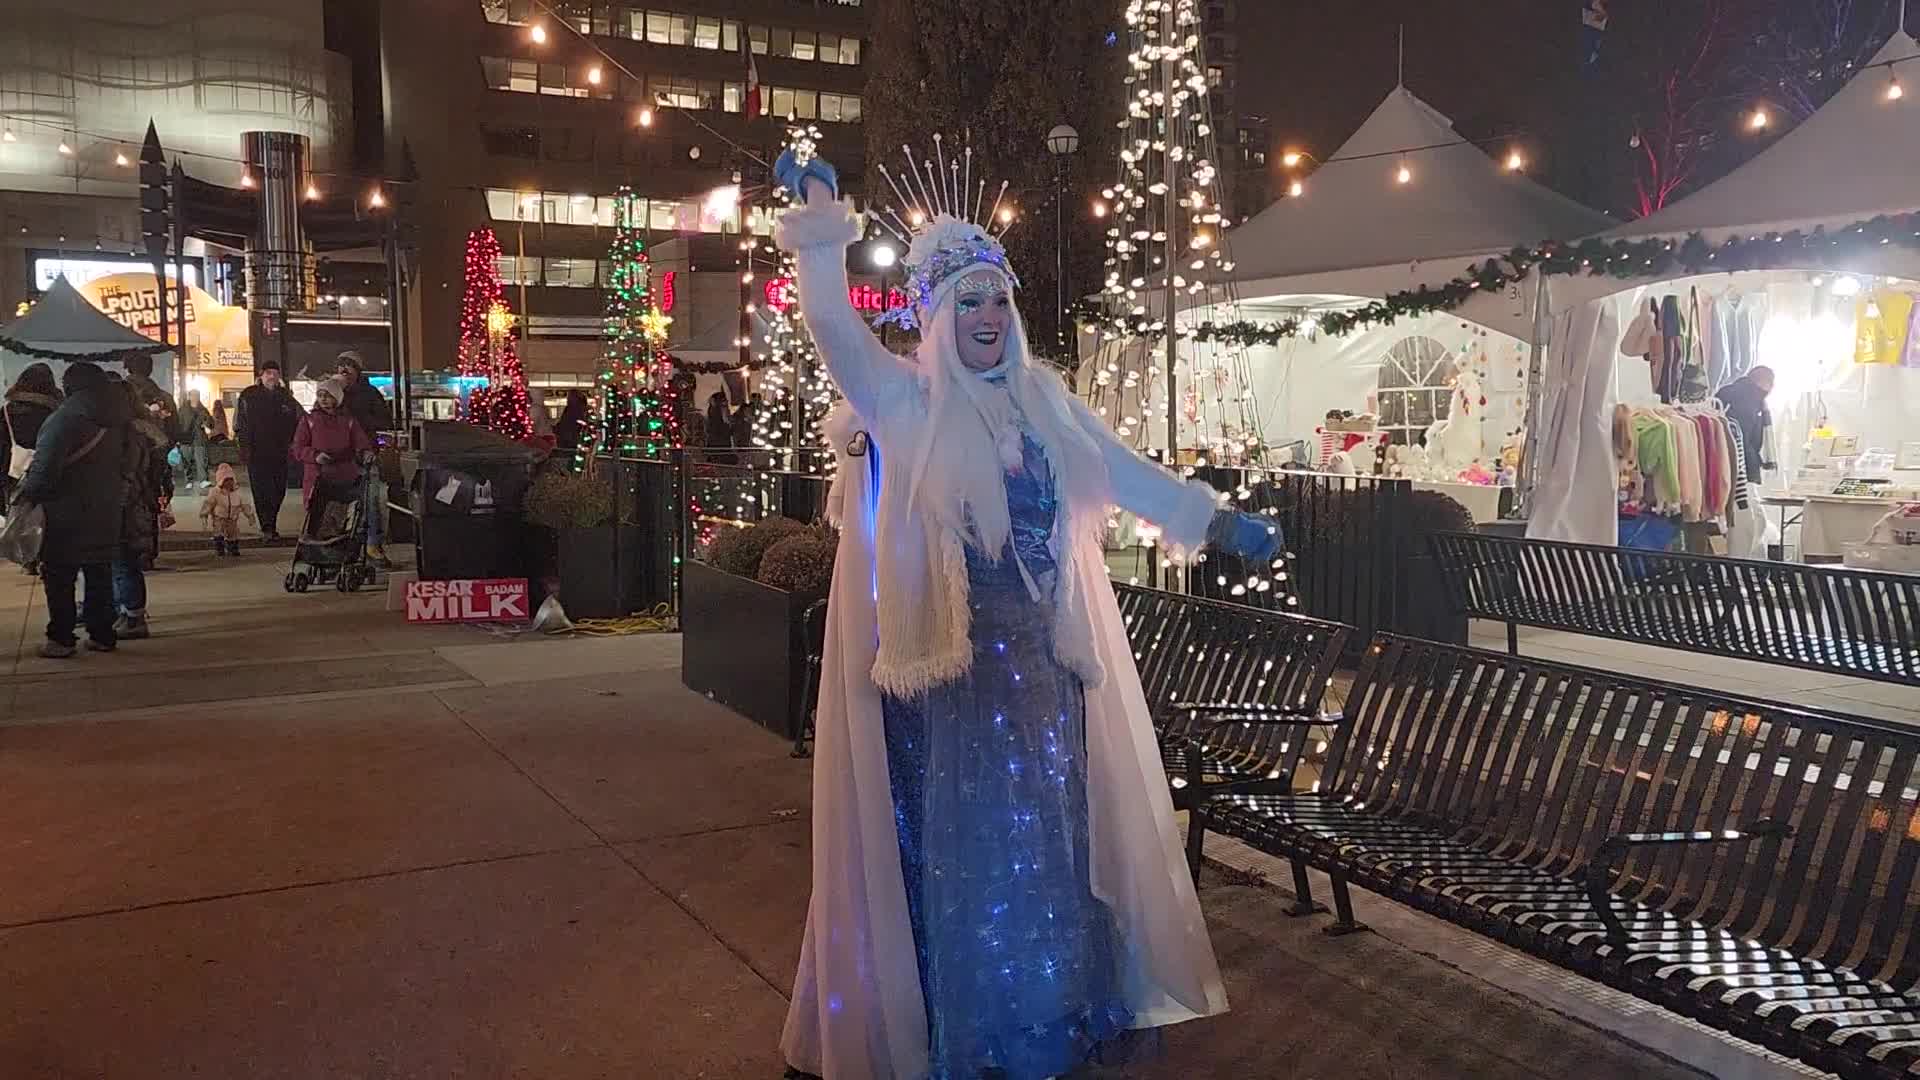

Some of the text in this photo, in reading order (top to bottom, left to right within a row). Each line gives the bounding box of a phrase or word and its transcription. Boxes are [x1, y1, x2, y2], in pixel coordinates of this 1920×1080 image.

[408, 580, 523, 597] KESAR BADAM
[407, 594, 526, 620] MILK
